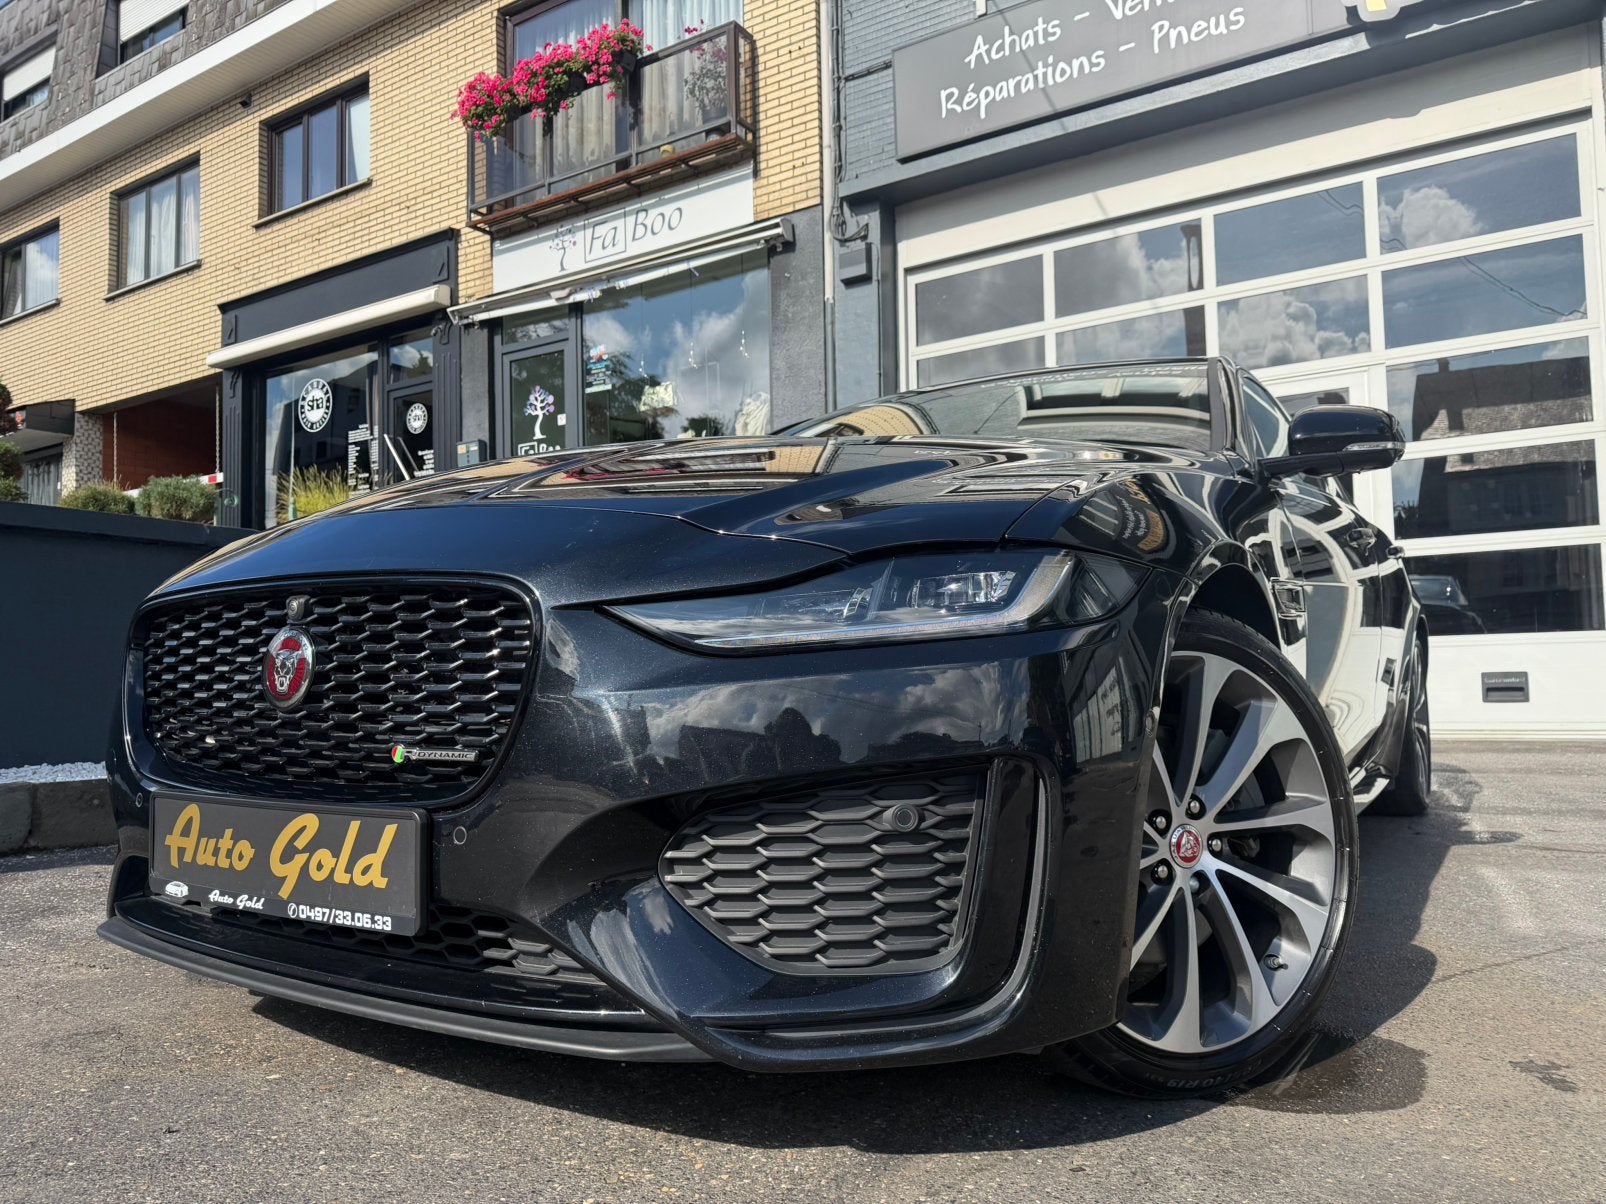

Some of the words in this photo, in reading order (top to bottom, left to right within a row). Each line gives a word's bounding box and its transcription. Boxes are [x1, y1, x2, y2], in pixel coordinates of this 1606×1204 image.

[940, 50, 1106, 119] Réparations
[1150, 7, 1246, 54] Pneus
[964, 16, 1062, 69] Achats
[588, 219, 619, 255] Fa
[631, 207, 683, 243] Boo
[418, 751, 474, 760] DYNAMIC
[164, 803, 256, 872] Auto
[269, 812, 399, 901] Gold
[208, 889, 235, 905] Auto
[236, 894, 265, 911] Gold
[298, 904, 392, 931] 0497/33.06.33
